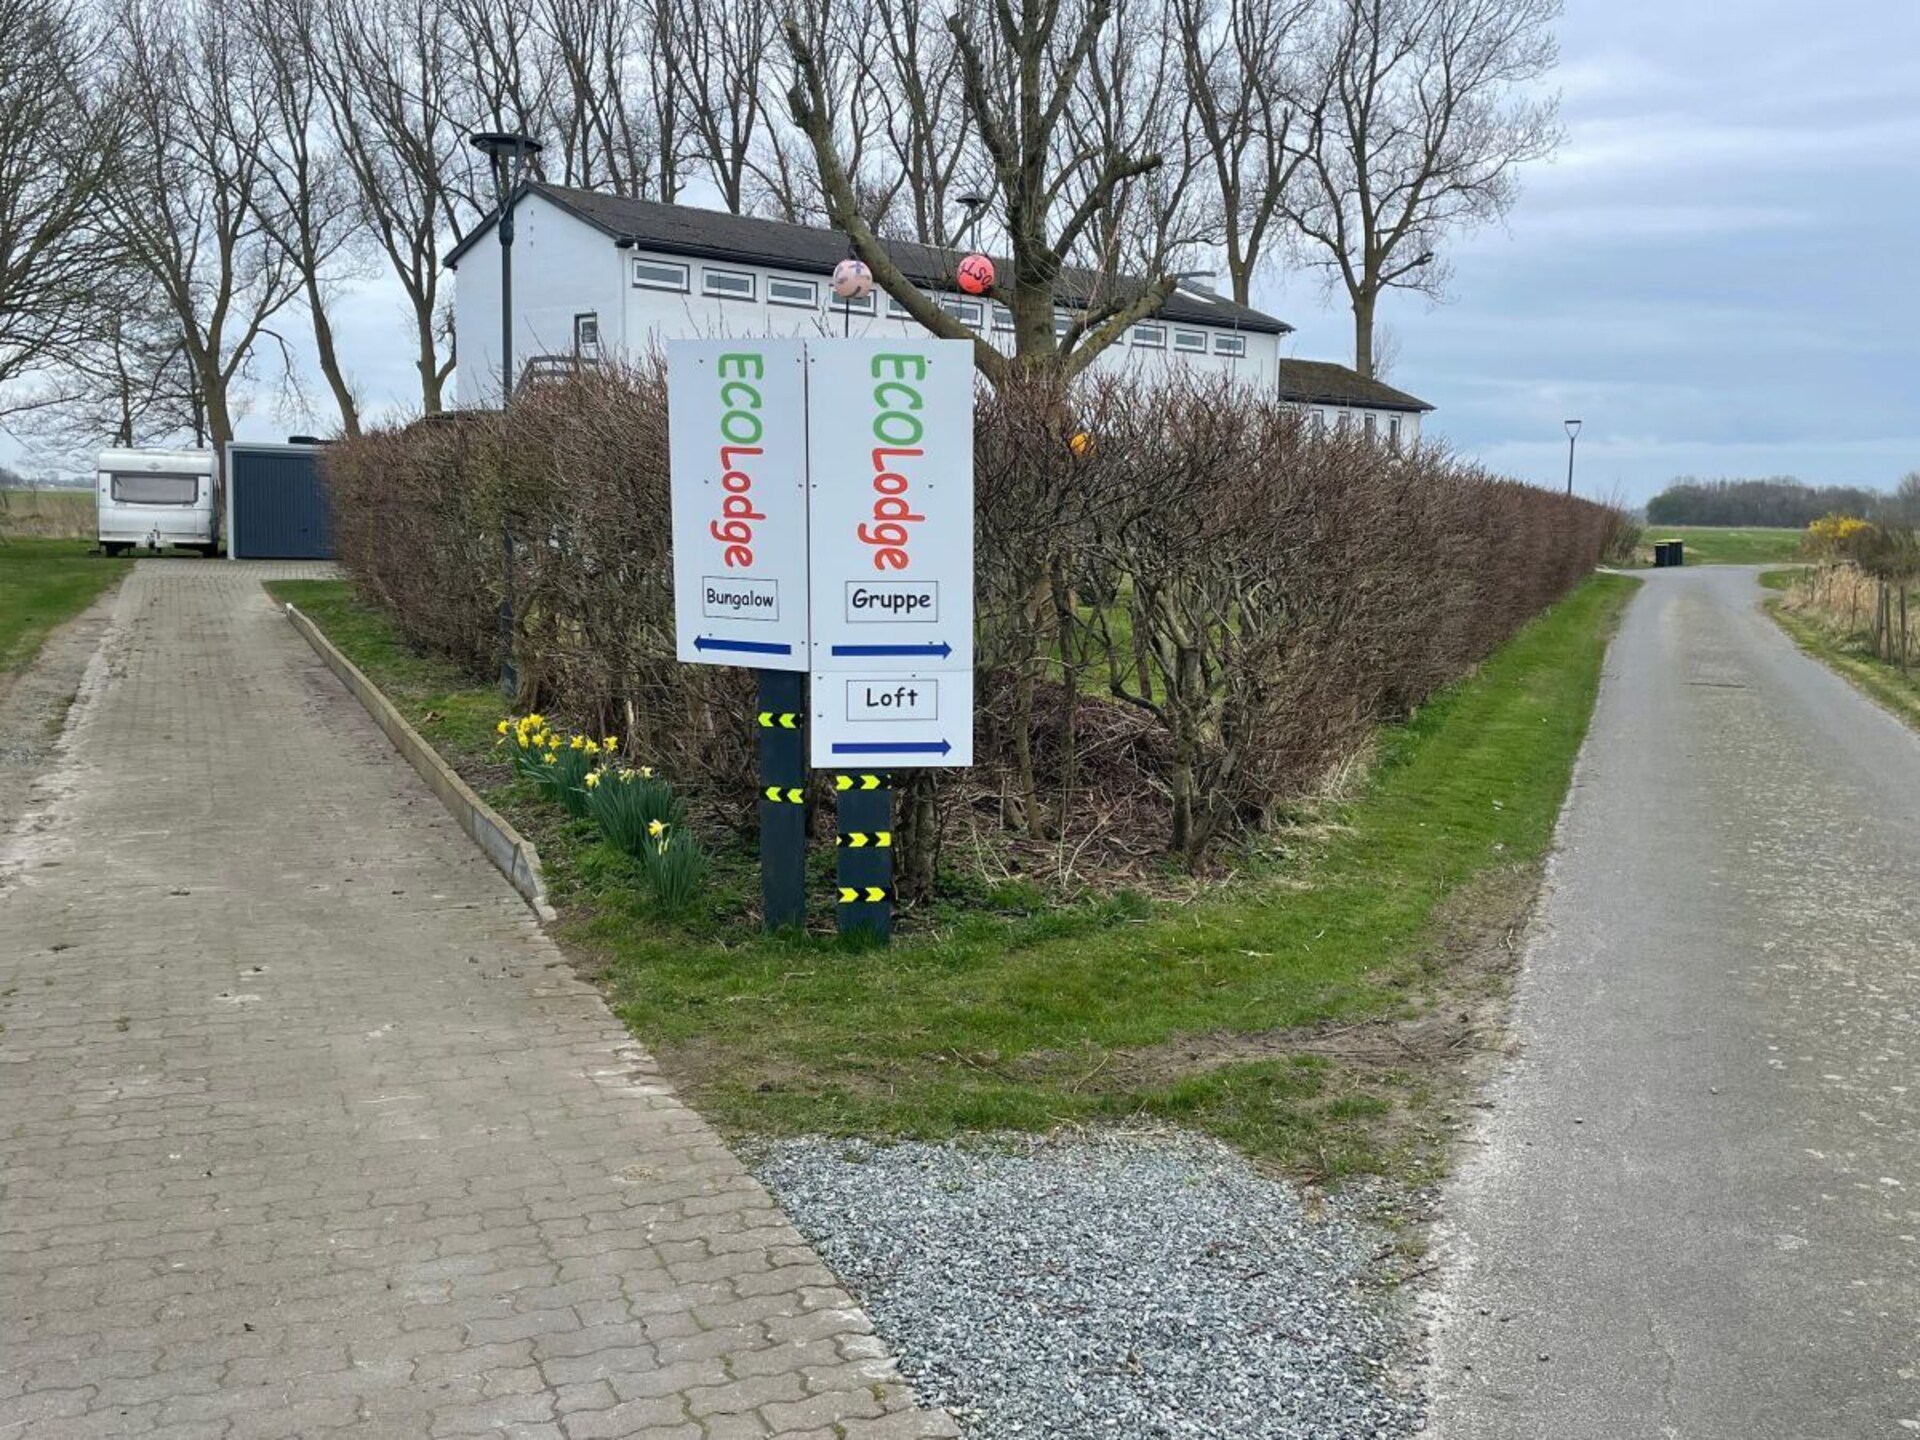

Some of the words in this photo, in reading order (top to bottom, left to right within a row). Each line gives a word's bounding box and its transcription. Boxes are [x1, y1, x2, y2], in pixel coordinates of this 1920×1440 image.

[710, 354, 766, 568] ECOLodge
[857, 353, 926, 571] ECOLodge
[706, 588, 774, 610] Bungalow
[852, 588, 931, 613] Gruppe
[866, 687, 918, 708] Loft
